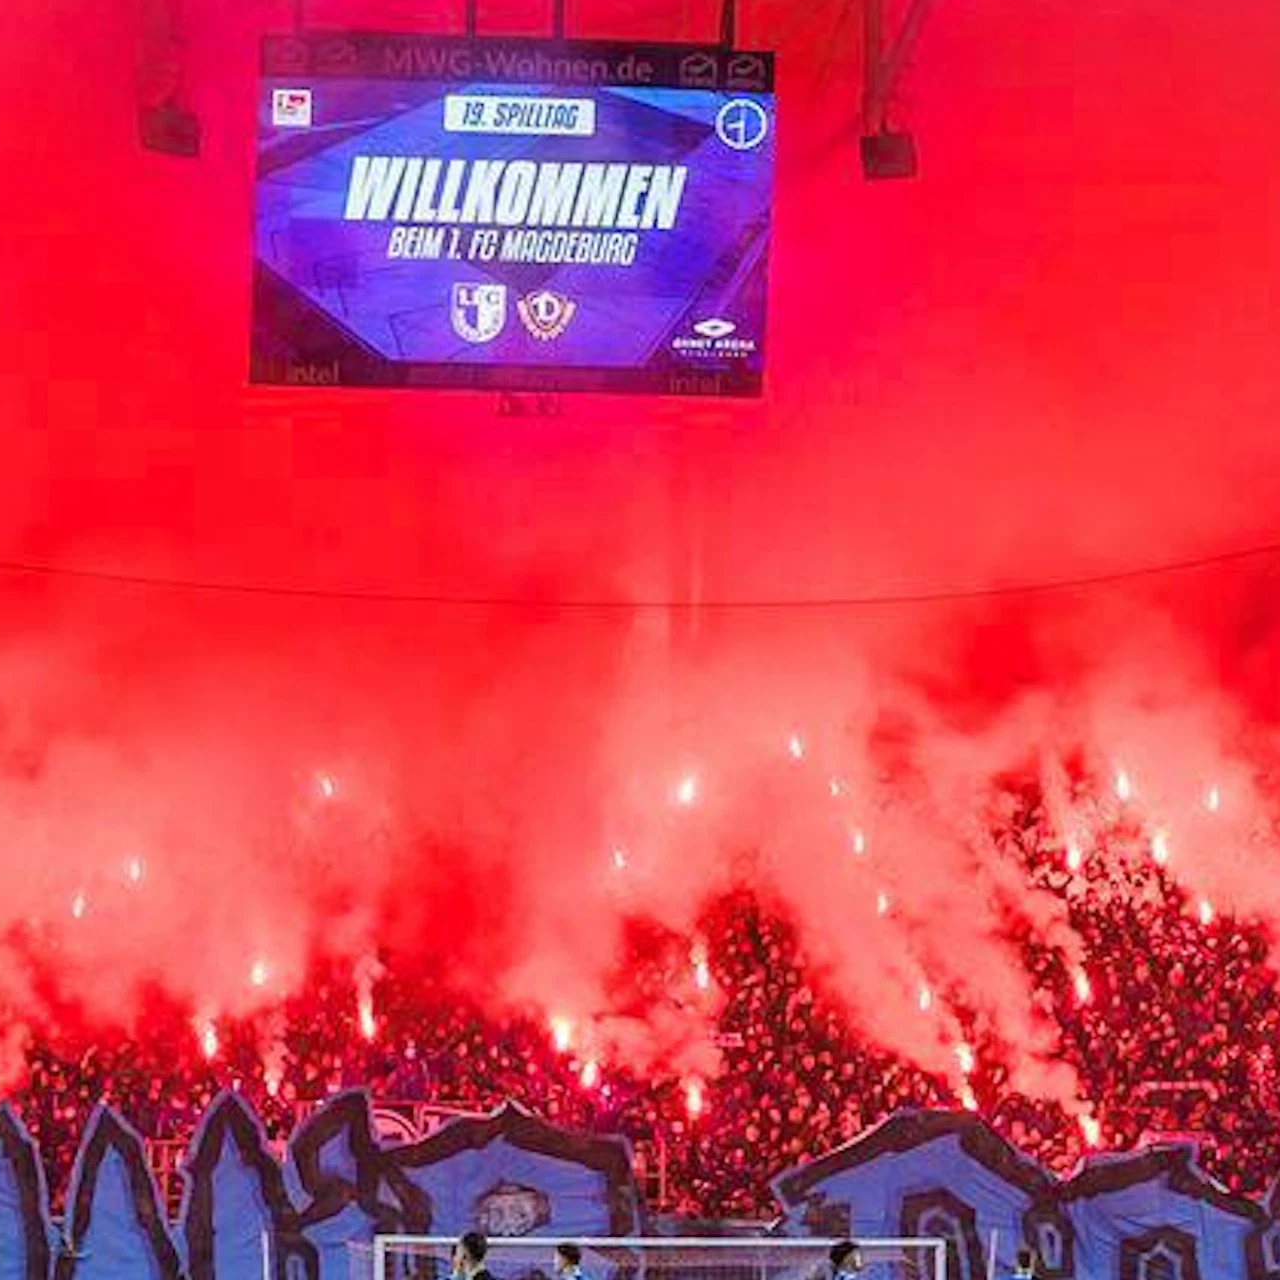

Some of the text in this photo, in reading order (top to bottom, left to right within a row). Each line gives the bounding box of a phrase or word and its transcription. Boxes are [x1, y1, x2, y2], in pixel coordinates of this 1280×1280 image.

[382, 48, 654, 83] MWG-Wohnen.de
[344, 156, 689, 230] WILLKOMMEN
[388, 226, 446, 260] BEIM
[467, 230, 499, 263] FC
[500, 231, 639, 267] MAGDEBURG
